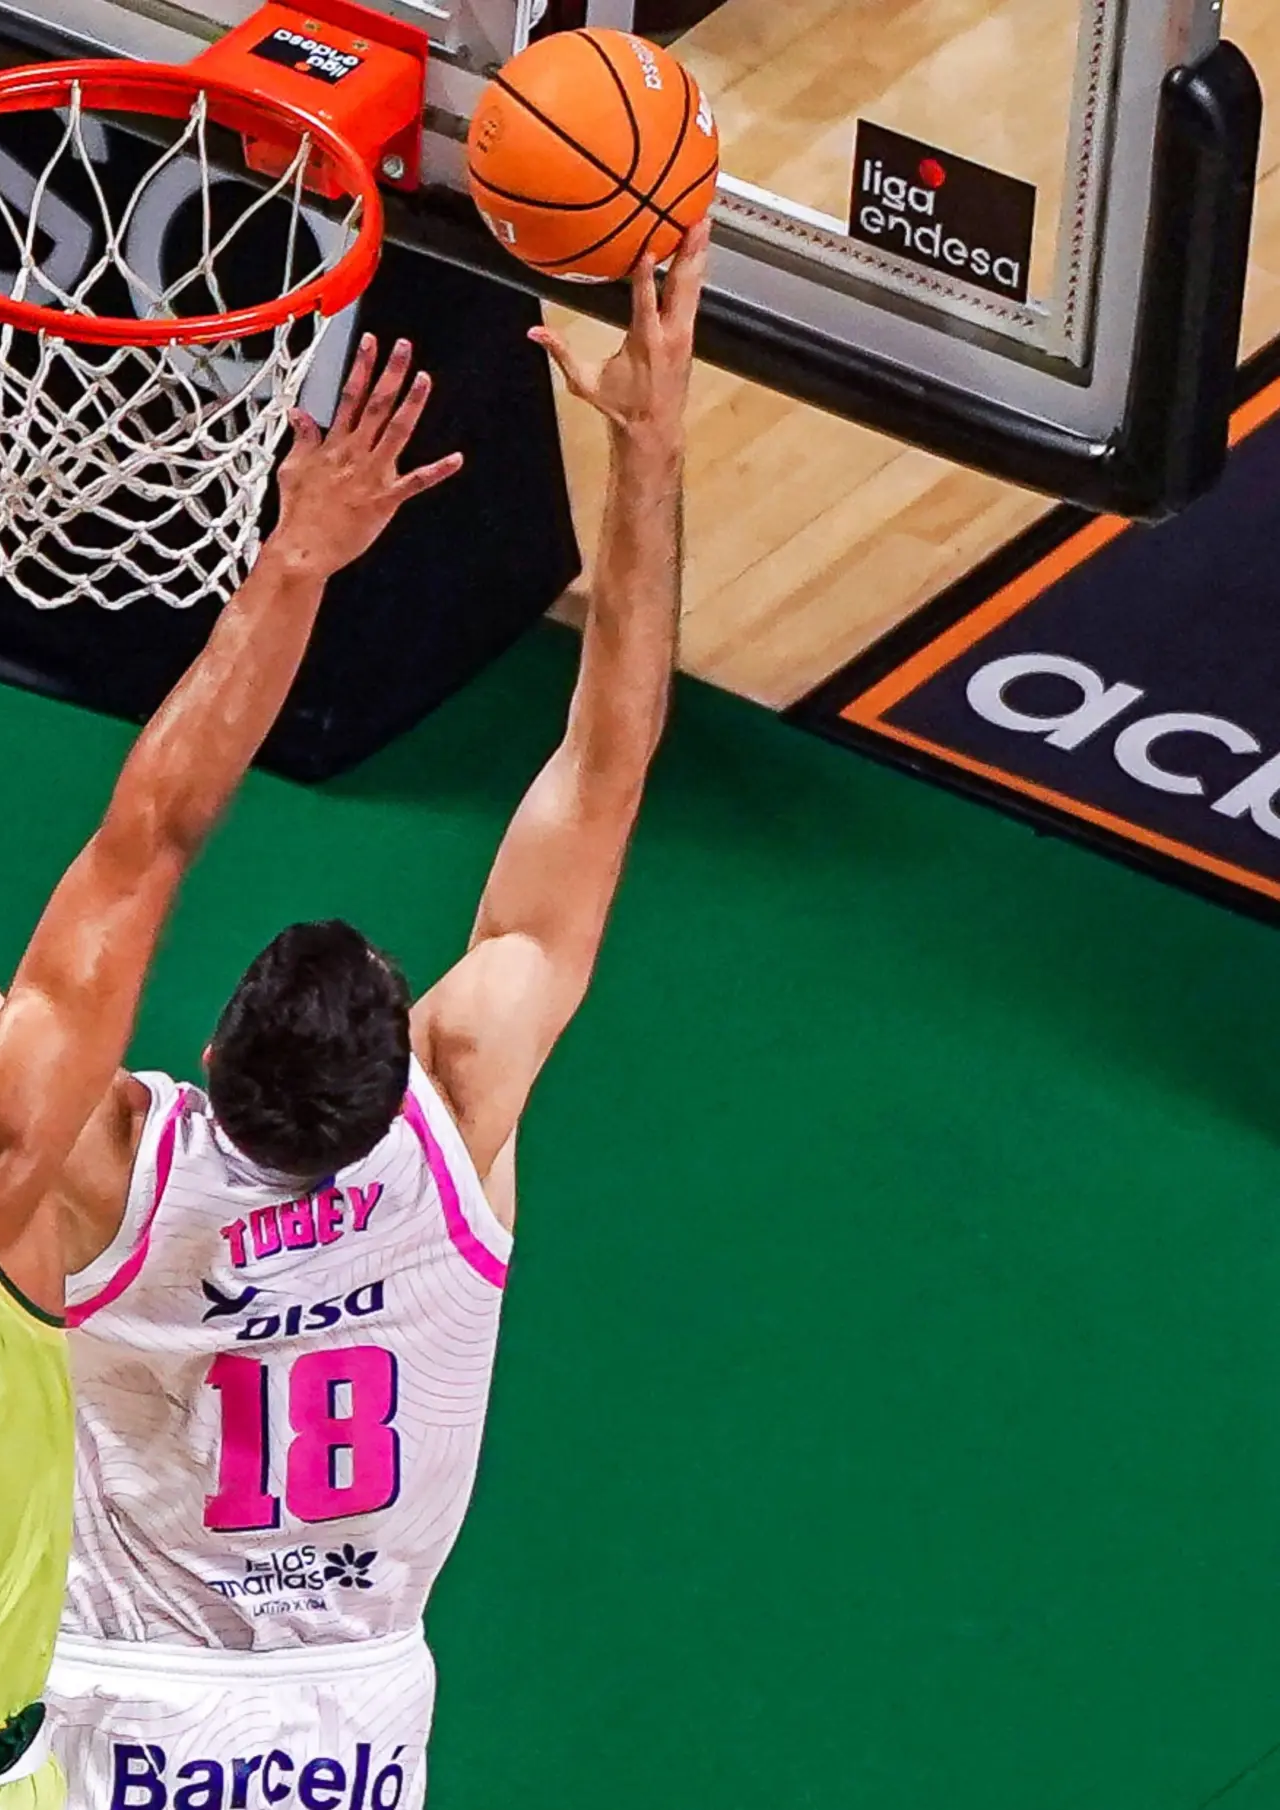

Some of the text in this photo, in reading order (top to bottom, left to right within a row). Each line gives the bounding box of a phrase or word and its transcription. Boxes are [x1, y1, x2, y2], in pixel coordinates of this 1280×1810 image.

[862, 159, 935, 216] liga
[860, 205, 1020, 288] endesa
[220, 1181, 384, 1268] TOBEY
[203, 1345, 401, 1532] 18
[110, 1743, 408, 1810] Barceló
